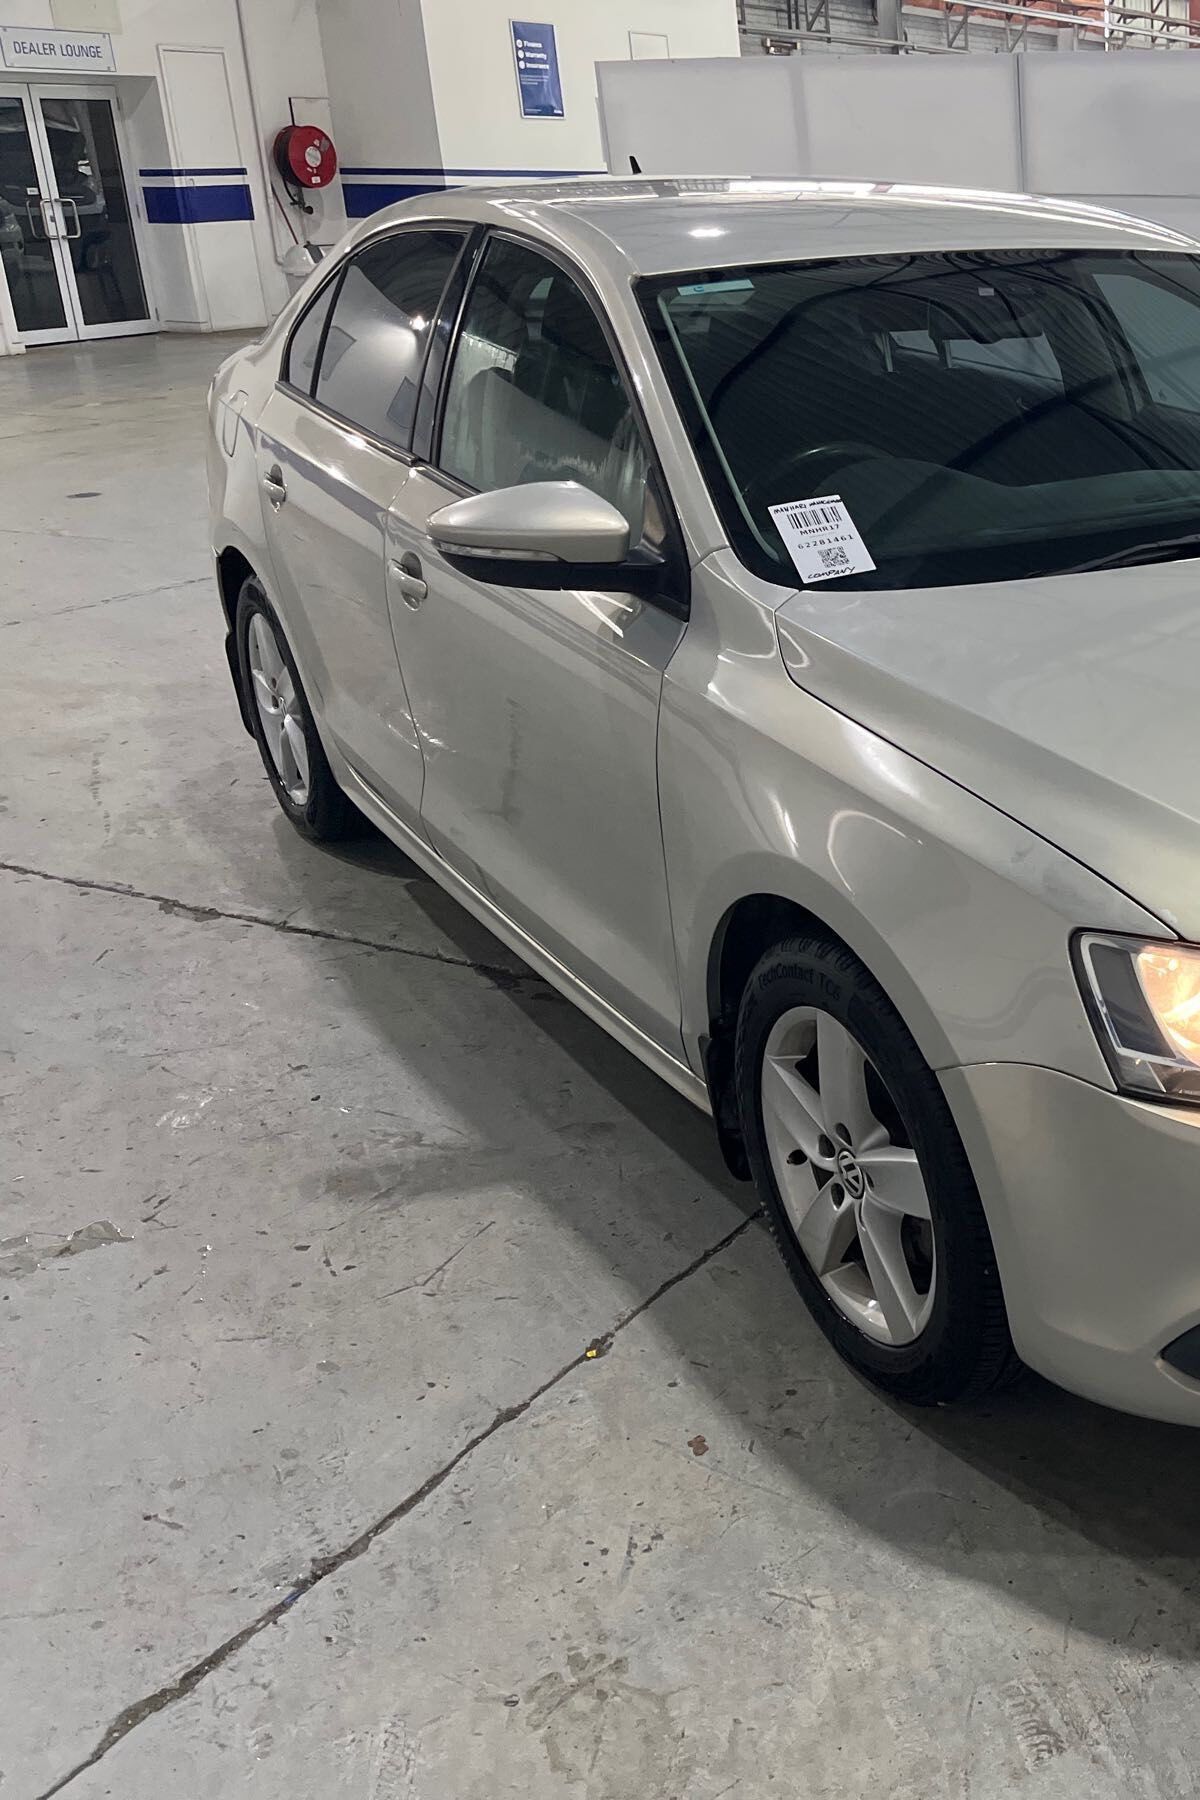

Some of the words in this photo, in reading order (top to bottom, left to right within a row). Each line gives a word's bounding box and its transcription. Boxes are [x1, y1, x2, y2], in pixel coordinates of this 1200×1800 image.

[13, 41, 56, 56] DEALER
[60, 44, 102, 58] LOUNGE
[800, 524, 839, 536] MNHR17
[798, 534, 853, 549] 62281461
[807, 566, 855, 579] COMPANY
